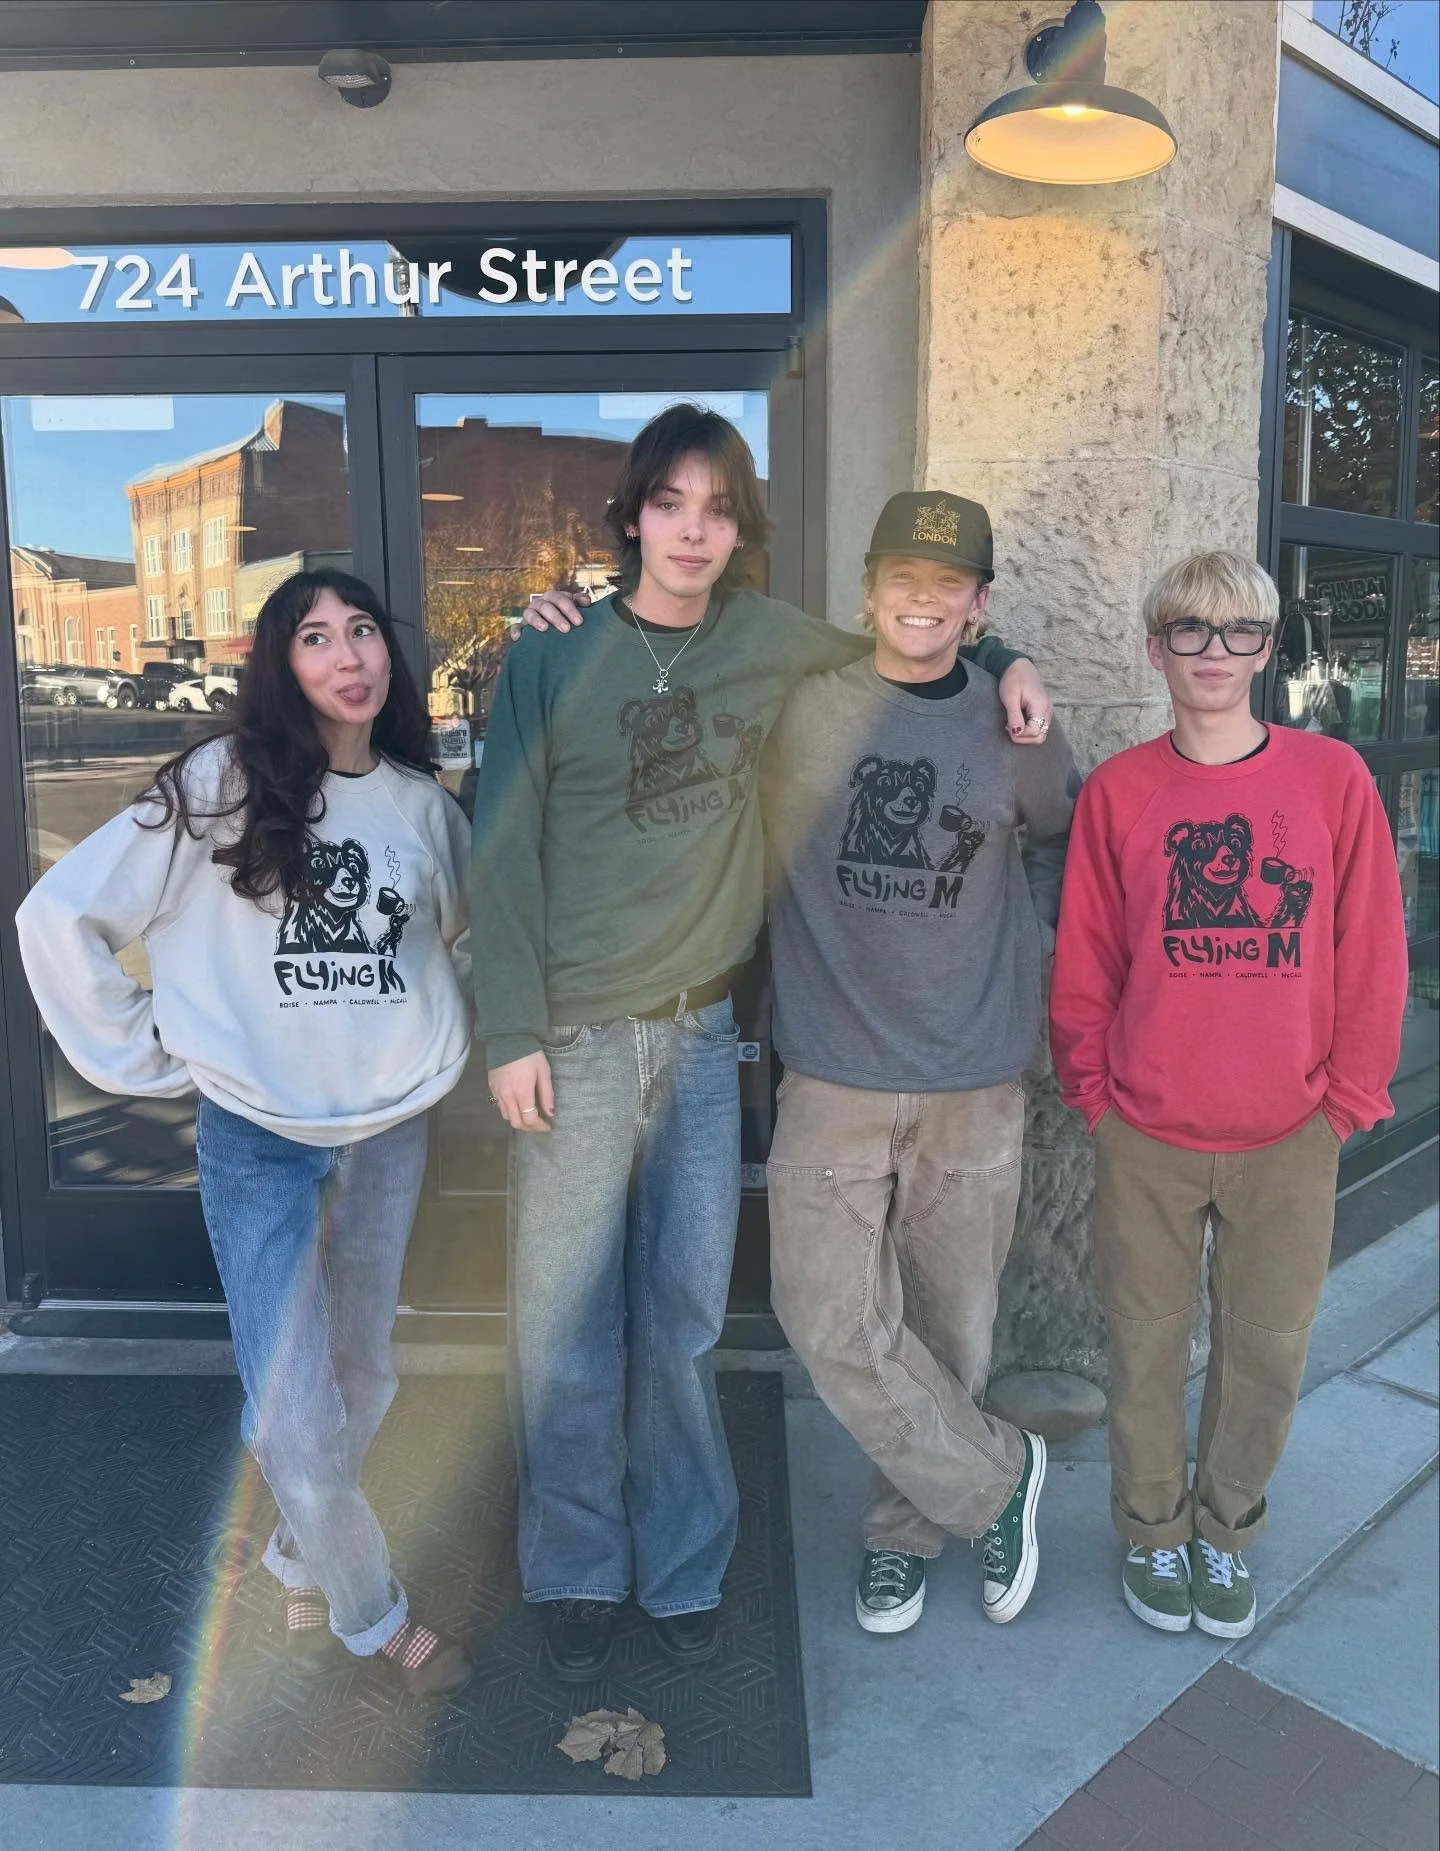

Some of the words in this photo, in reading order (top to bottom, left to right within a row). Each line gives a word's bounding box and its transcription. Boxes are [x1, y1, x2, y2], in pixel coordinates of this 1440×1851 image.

[73, 253, 200, 310] 724
[225, 248, 452, 306] Arthur
[478, 247, 692, 303] Street
[912, 531, 957, 547] LONDON
[928, 875, 964, 909] M
[1266, 931, 1302, 968] M
[379, 958, 407, 995] M
[279, 1001, 300, 1009] BOISE
[313, 998, 338, 1006] NAMPA
[349, 998, 380, 1006] CALDWELL
